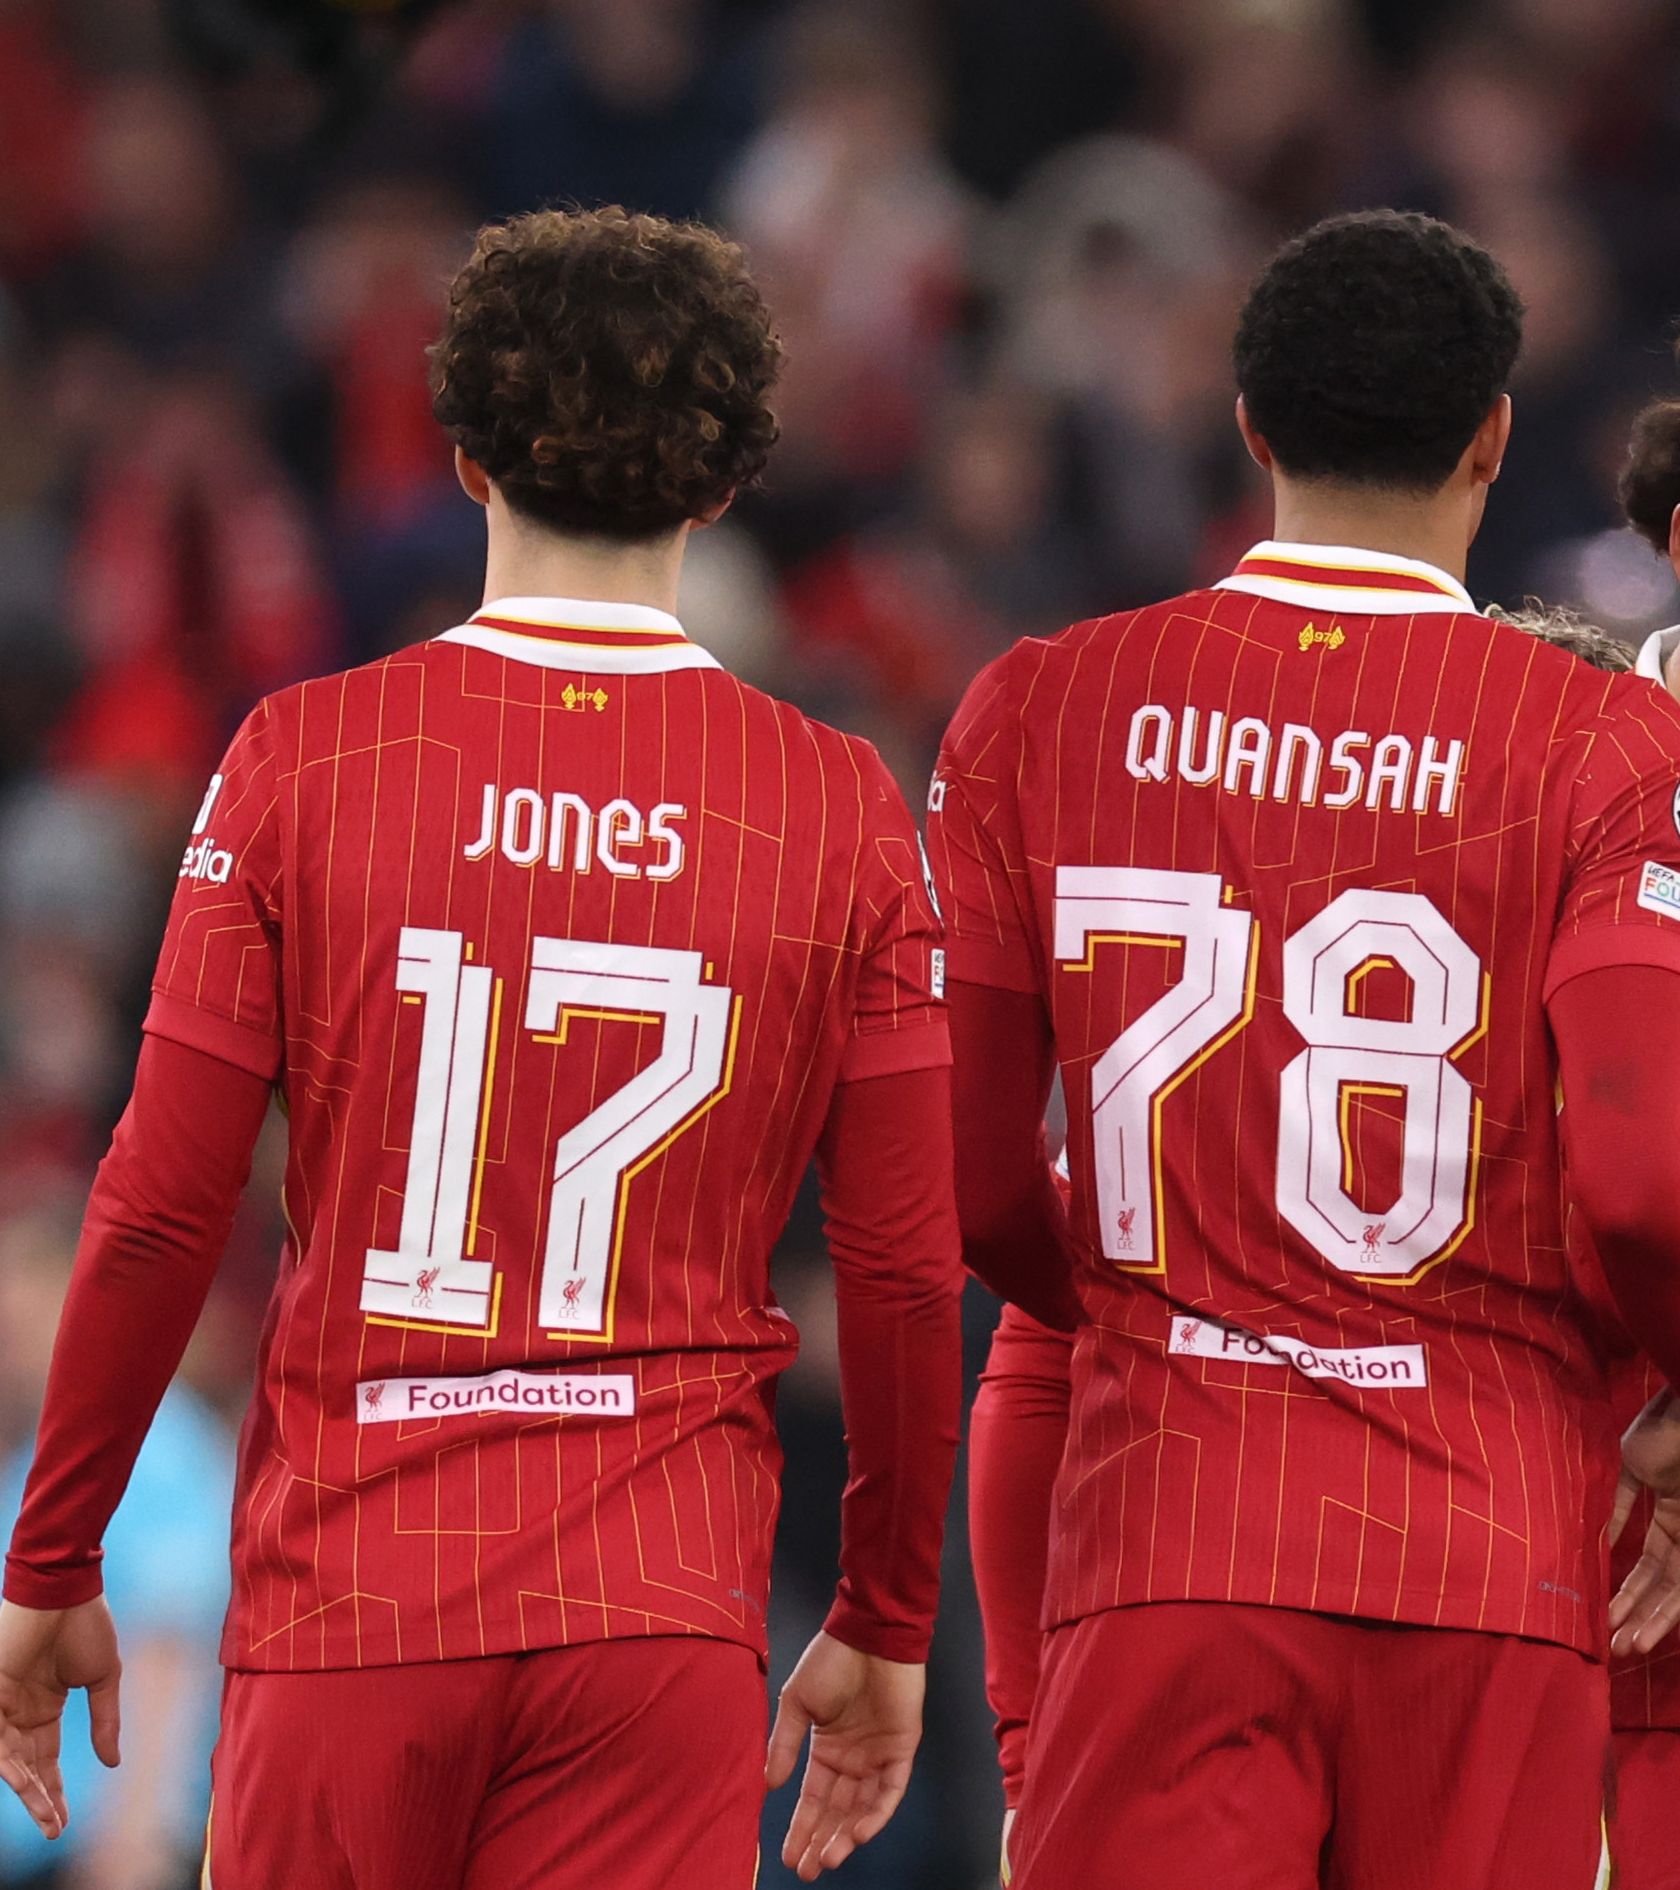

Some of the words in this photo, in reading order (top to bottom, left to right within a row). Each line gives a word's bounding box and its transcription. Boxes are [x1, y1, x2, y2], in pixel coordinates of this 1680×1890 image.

[1313, 631, 1332, 643] 97
[1125, 704, 1465, 818] QUANSAH
[1054, 865, 1491, 1285] 78
[358, 926, 742, 1343] 17
[408, 1377, 621, 1412] Foundation
[1221, 1327, 1411, 1381] Fodation
